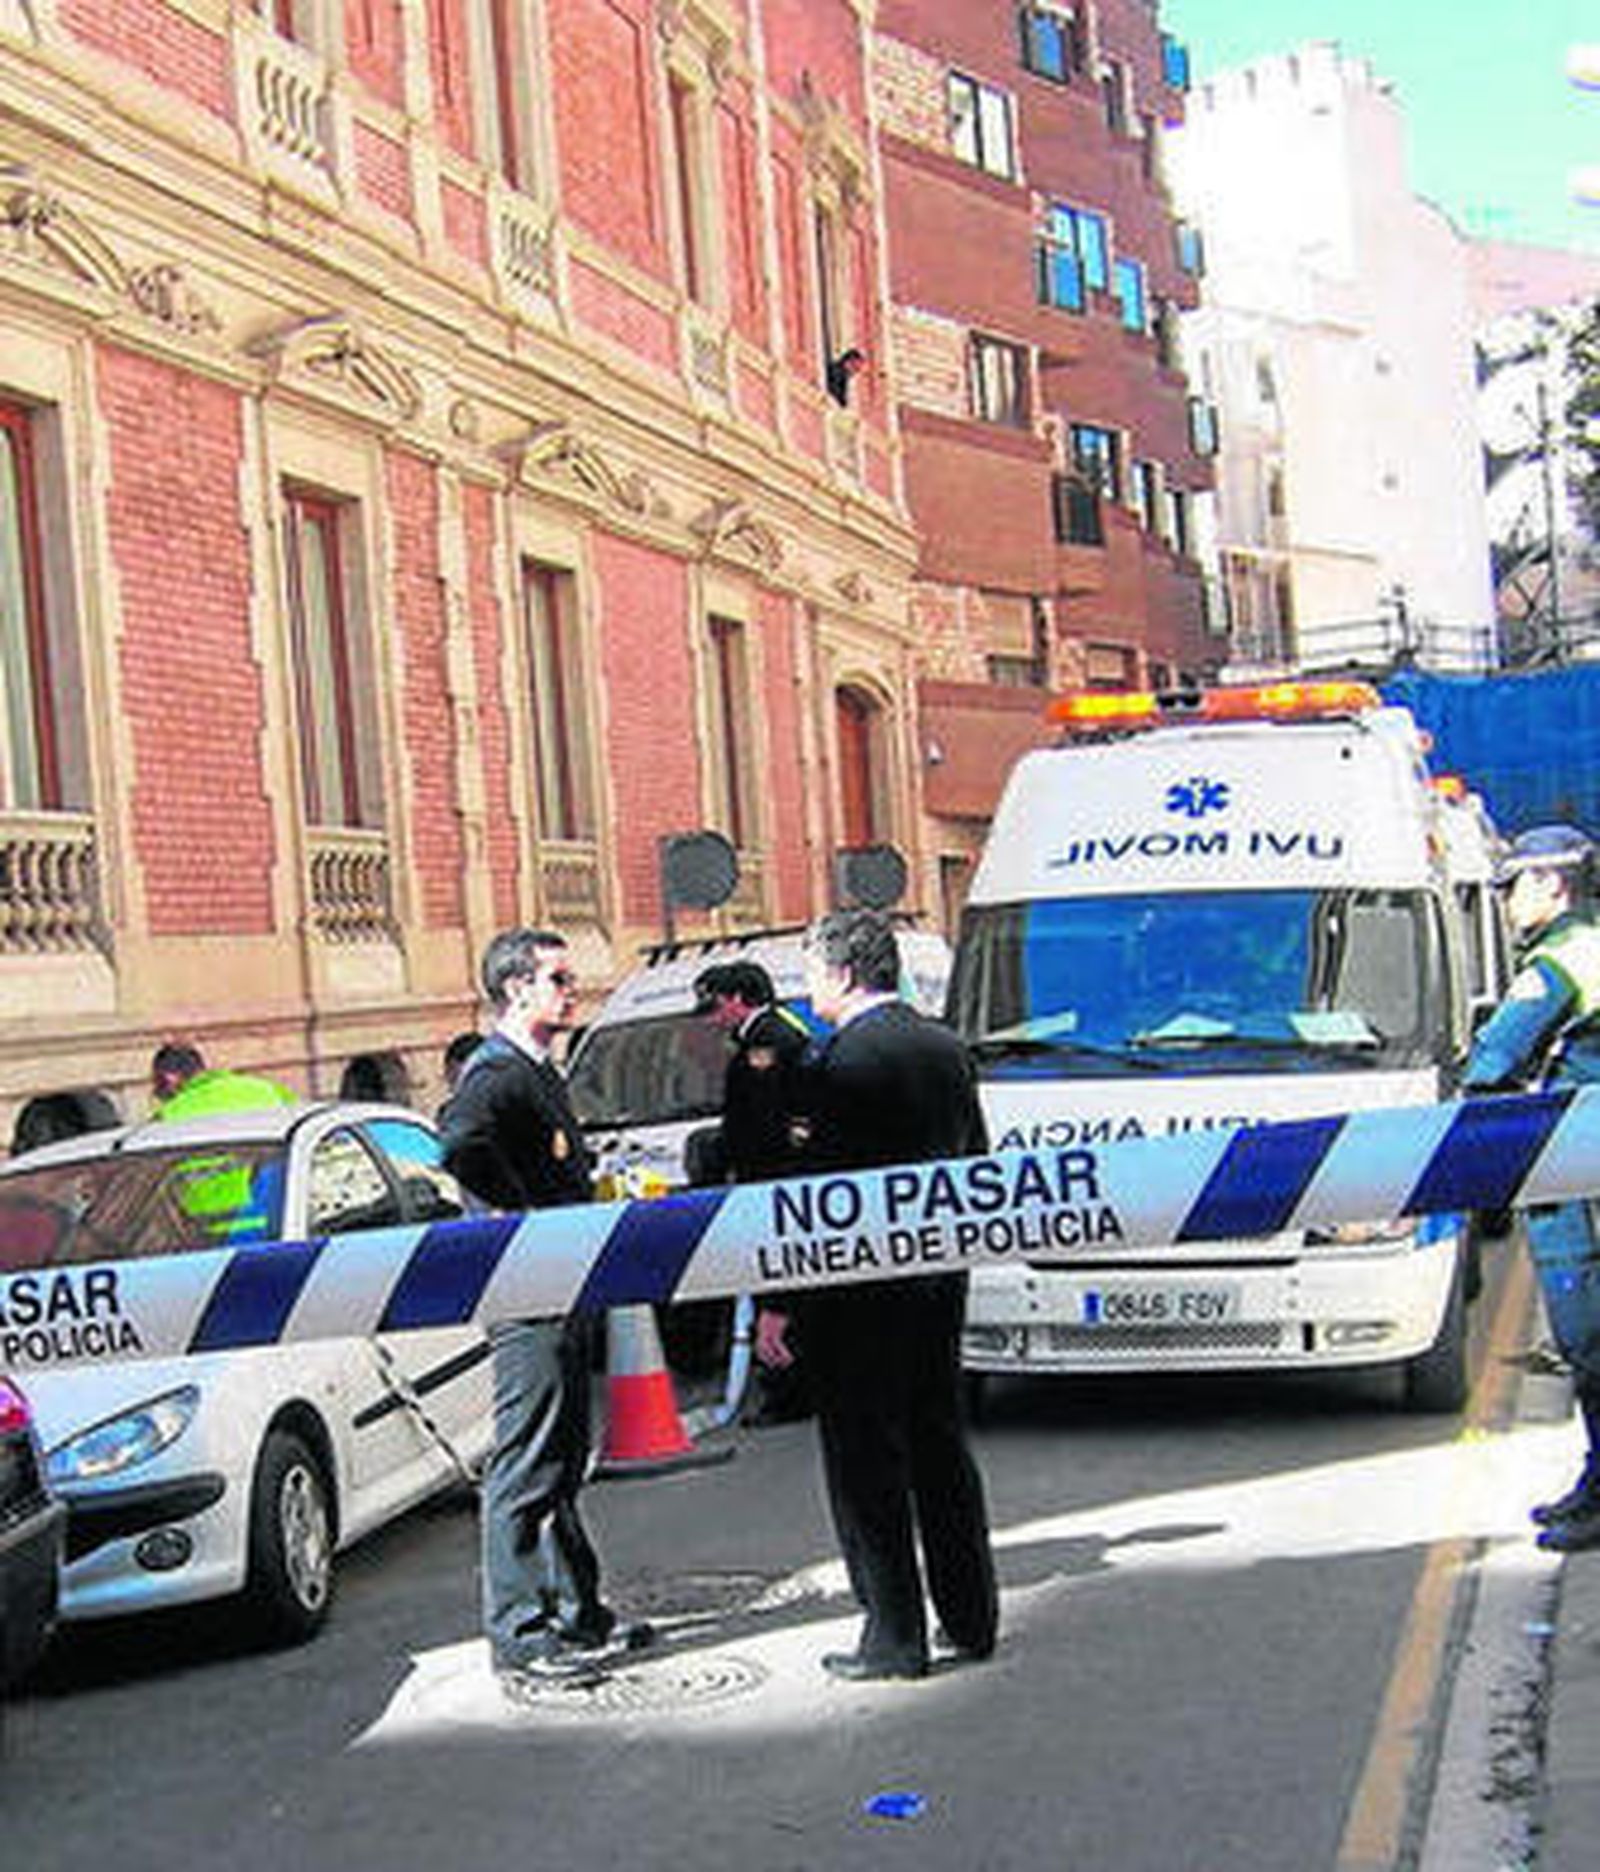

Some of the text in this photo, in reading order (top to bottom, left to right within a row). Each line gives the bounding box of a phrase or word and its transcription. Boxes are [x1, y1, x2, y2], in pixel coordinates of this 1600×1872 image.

[772, 1149, 1099, 1236] NO PASAR
[757, 1206, 1123, 1280] LINEA DE POLICIA
[4, 1320, 143, 1365] POLICIA
